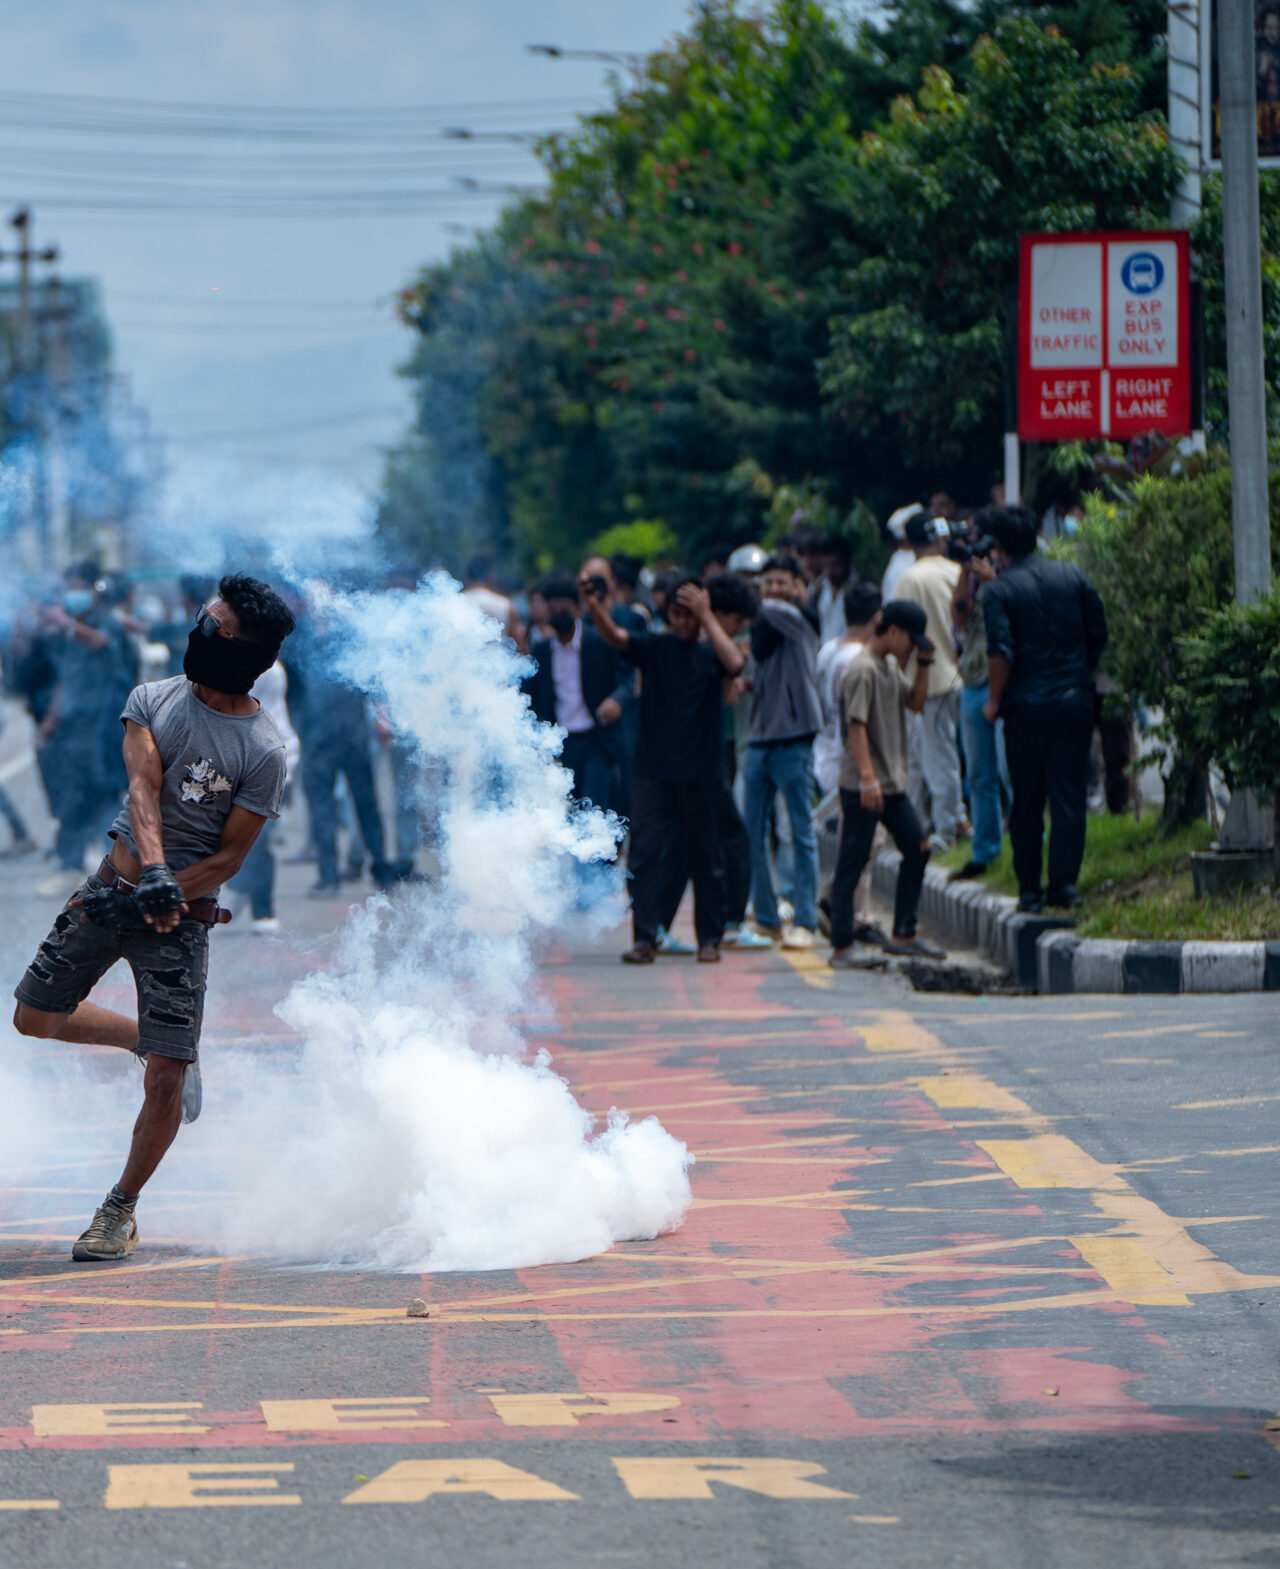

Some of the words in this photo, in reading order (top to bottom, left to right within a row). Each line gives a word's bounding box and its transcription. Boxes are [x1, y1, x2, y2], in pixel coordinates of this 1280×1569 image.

[1039, 307, 1092, 323] OTHER
[1125, 300, 1162, 316] EXP
[1125, 319, 1162, 335] BUS
[1034, 335, 1098, 351] TRAFFIC
[1119, 338, 1166, 355] ONLY
[1041, 381, 1091, 399] LEFT
[1115, 379, 1172, 397] RIGHT
[1040, 401, 1092, 419] LANE
[1115, 399, 1168, 418] LANE
